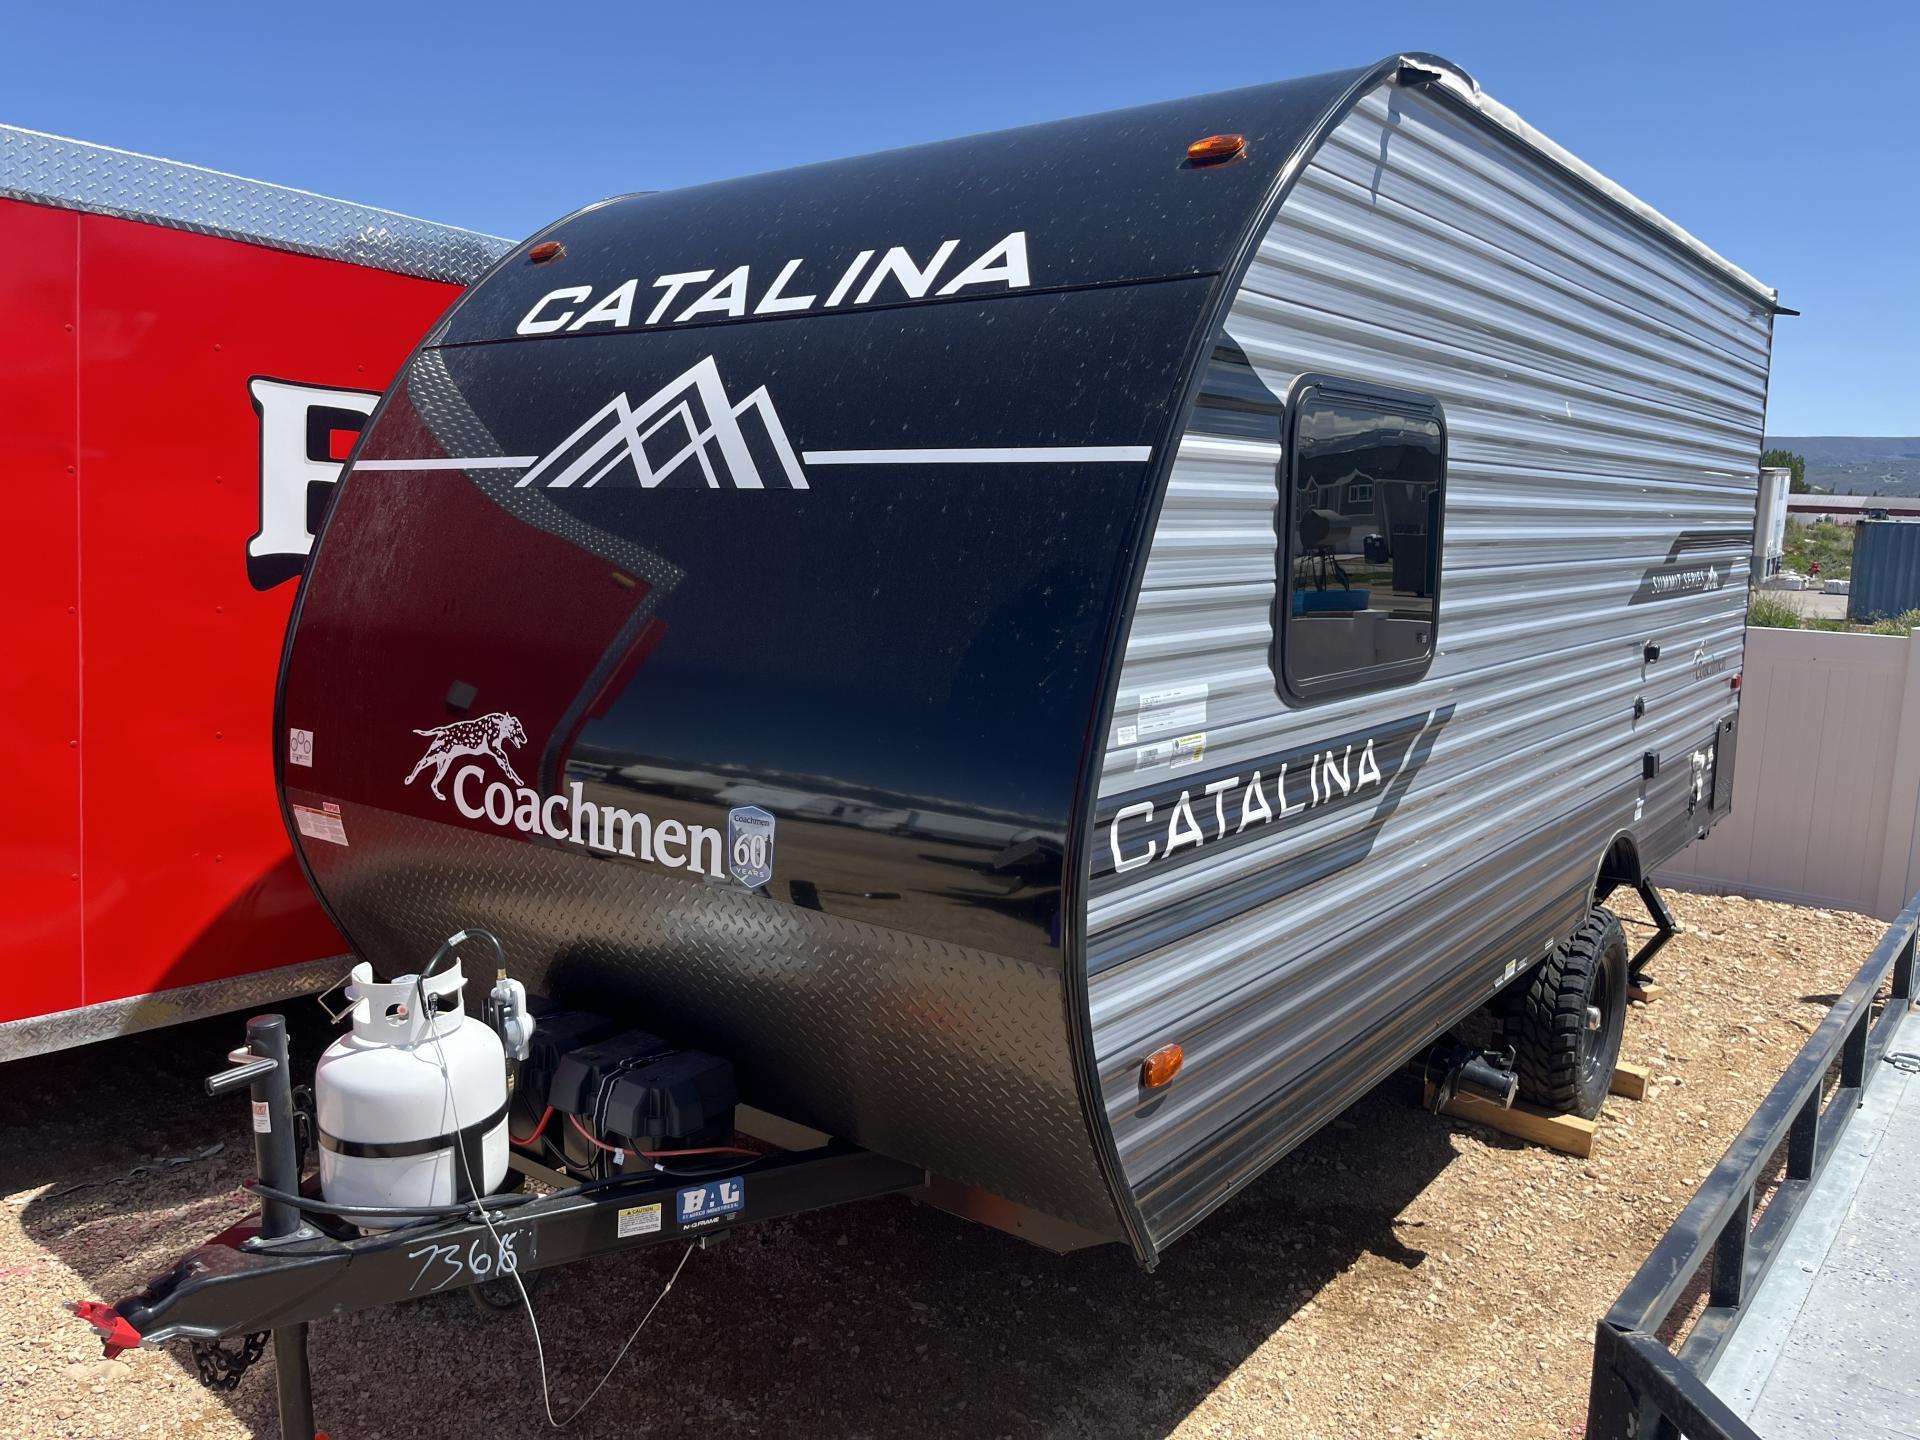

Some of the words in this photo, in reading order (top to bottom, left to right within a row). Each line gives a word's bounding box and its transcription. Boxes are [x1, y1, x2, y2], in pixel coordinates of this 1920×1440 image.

[516, 231, 1030, 335] CATALINA
[1651, 574, 1680, 594] SUMMIT
[1110, 738, 1381, 874] CATALINA
[453, 765, 726, 879] Coachmen
[734, 814, 770, 827] Coachmen
[733, 833, 767, 869] 60
[735, 867, 765, 878] YEARS
[632, 1206, 654, 1215] CAUTION
